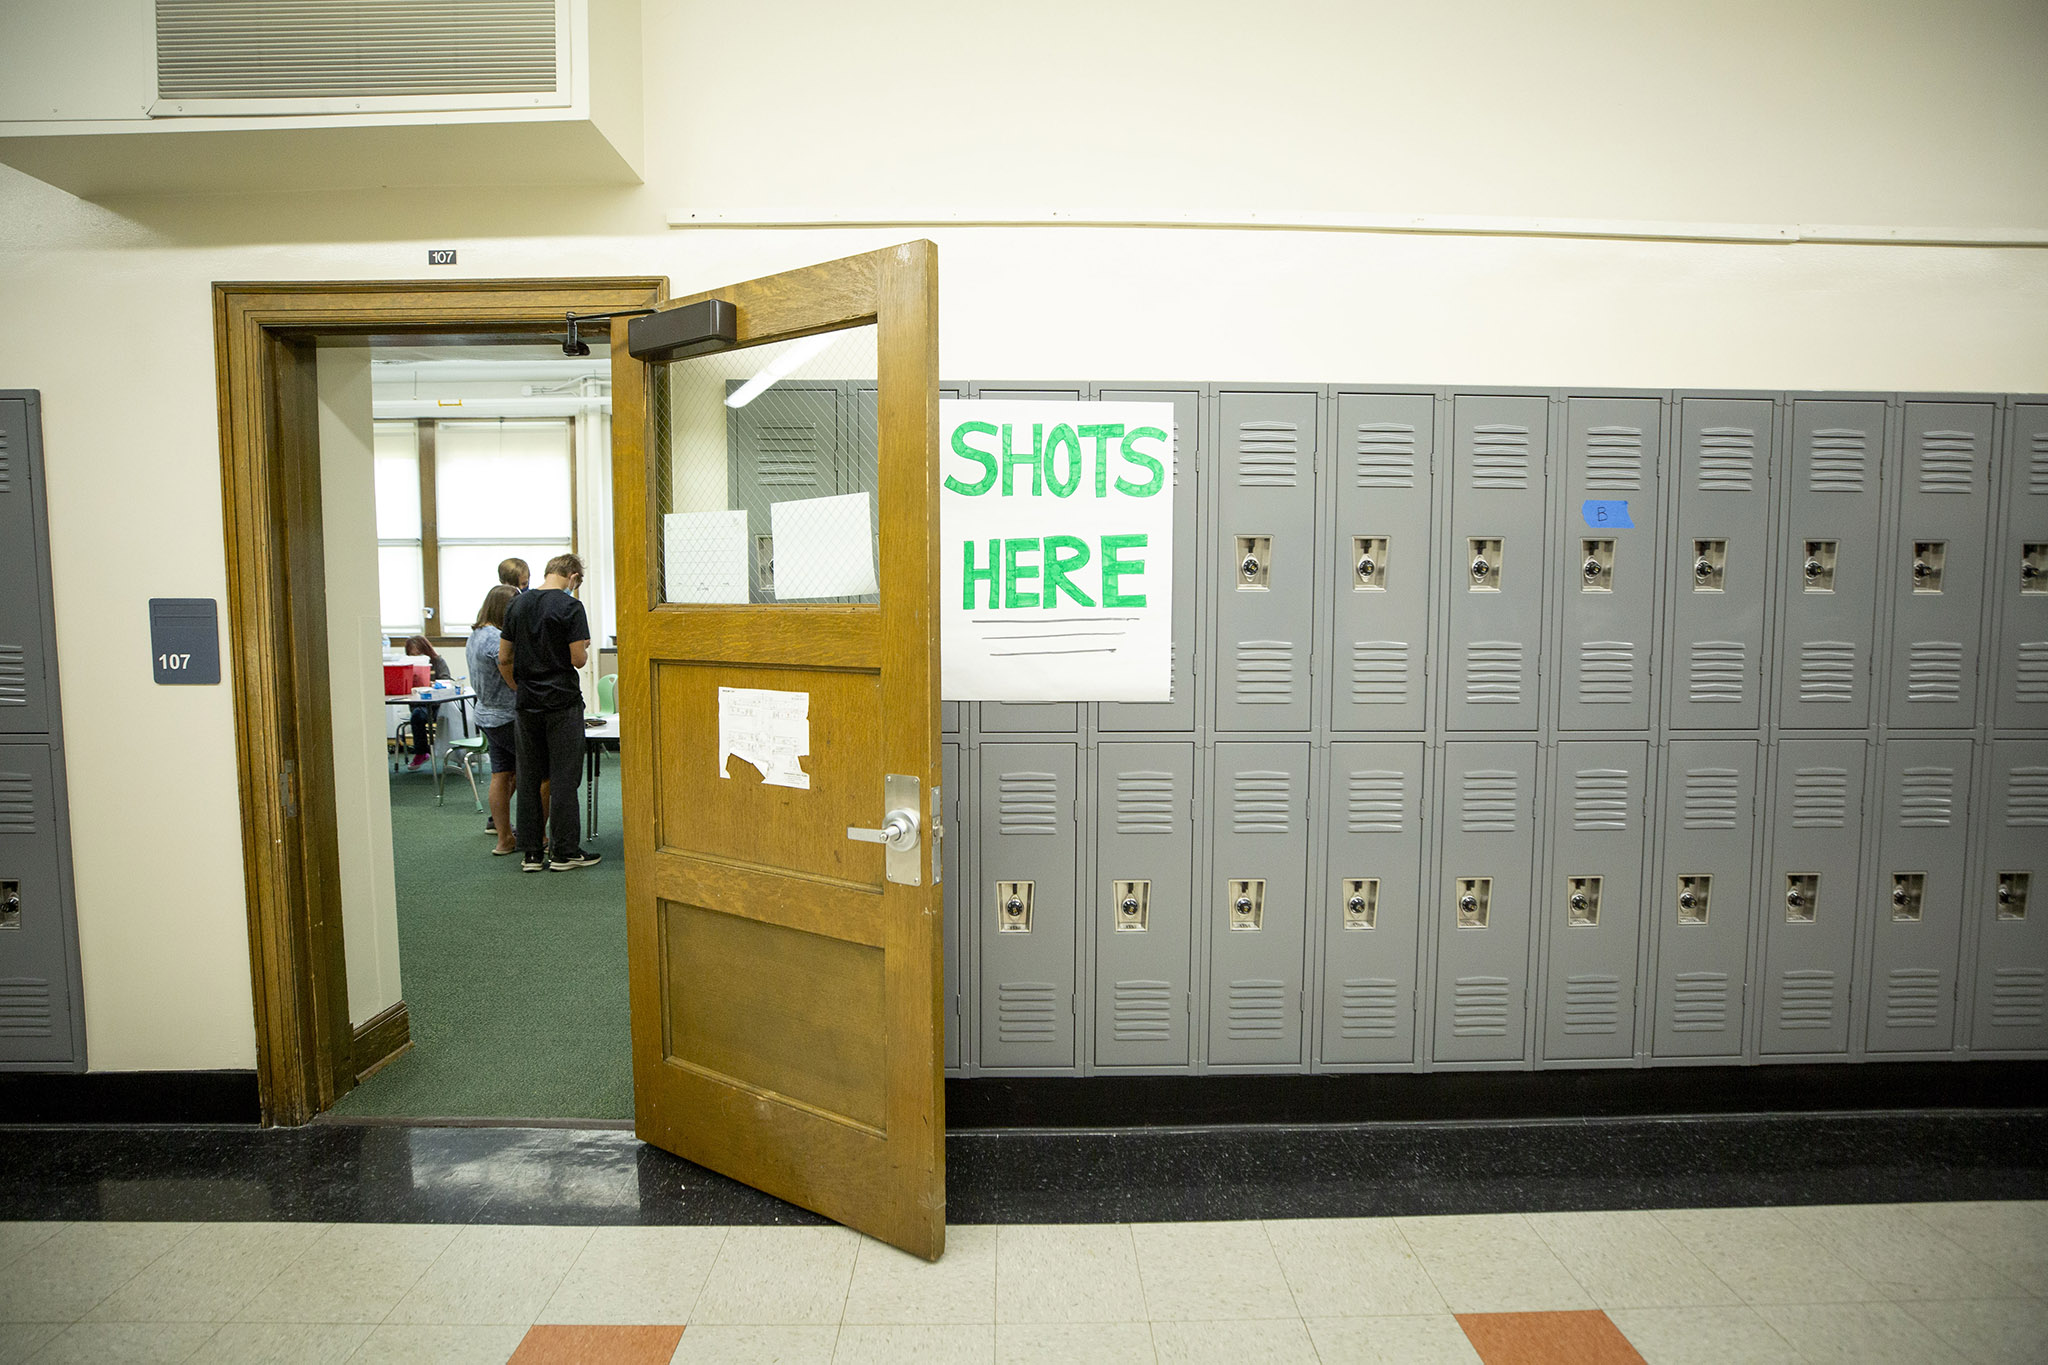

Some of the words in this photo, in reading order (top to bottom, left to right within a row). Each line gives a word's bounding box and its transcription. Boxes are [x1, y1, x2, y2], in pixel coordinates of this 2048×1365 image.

[432, 251, 454, 263] 107
[944, 421, 1168, 498] SHOTS
[1597, 506, 1609, 522] B
[963, 534, 1148, 610] HERE
[158, 653, 191, 670] 107
